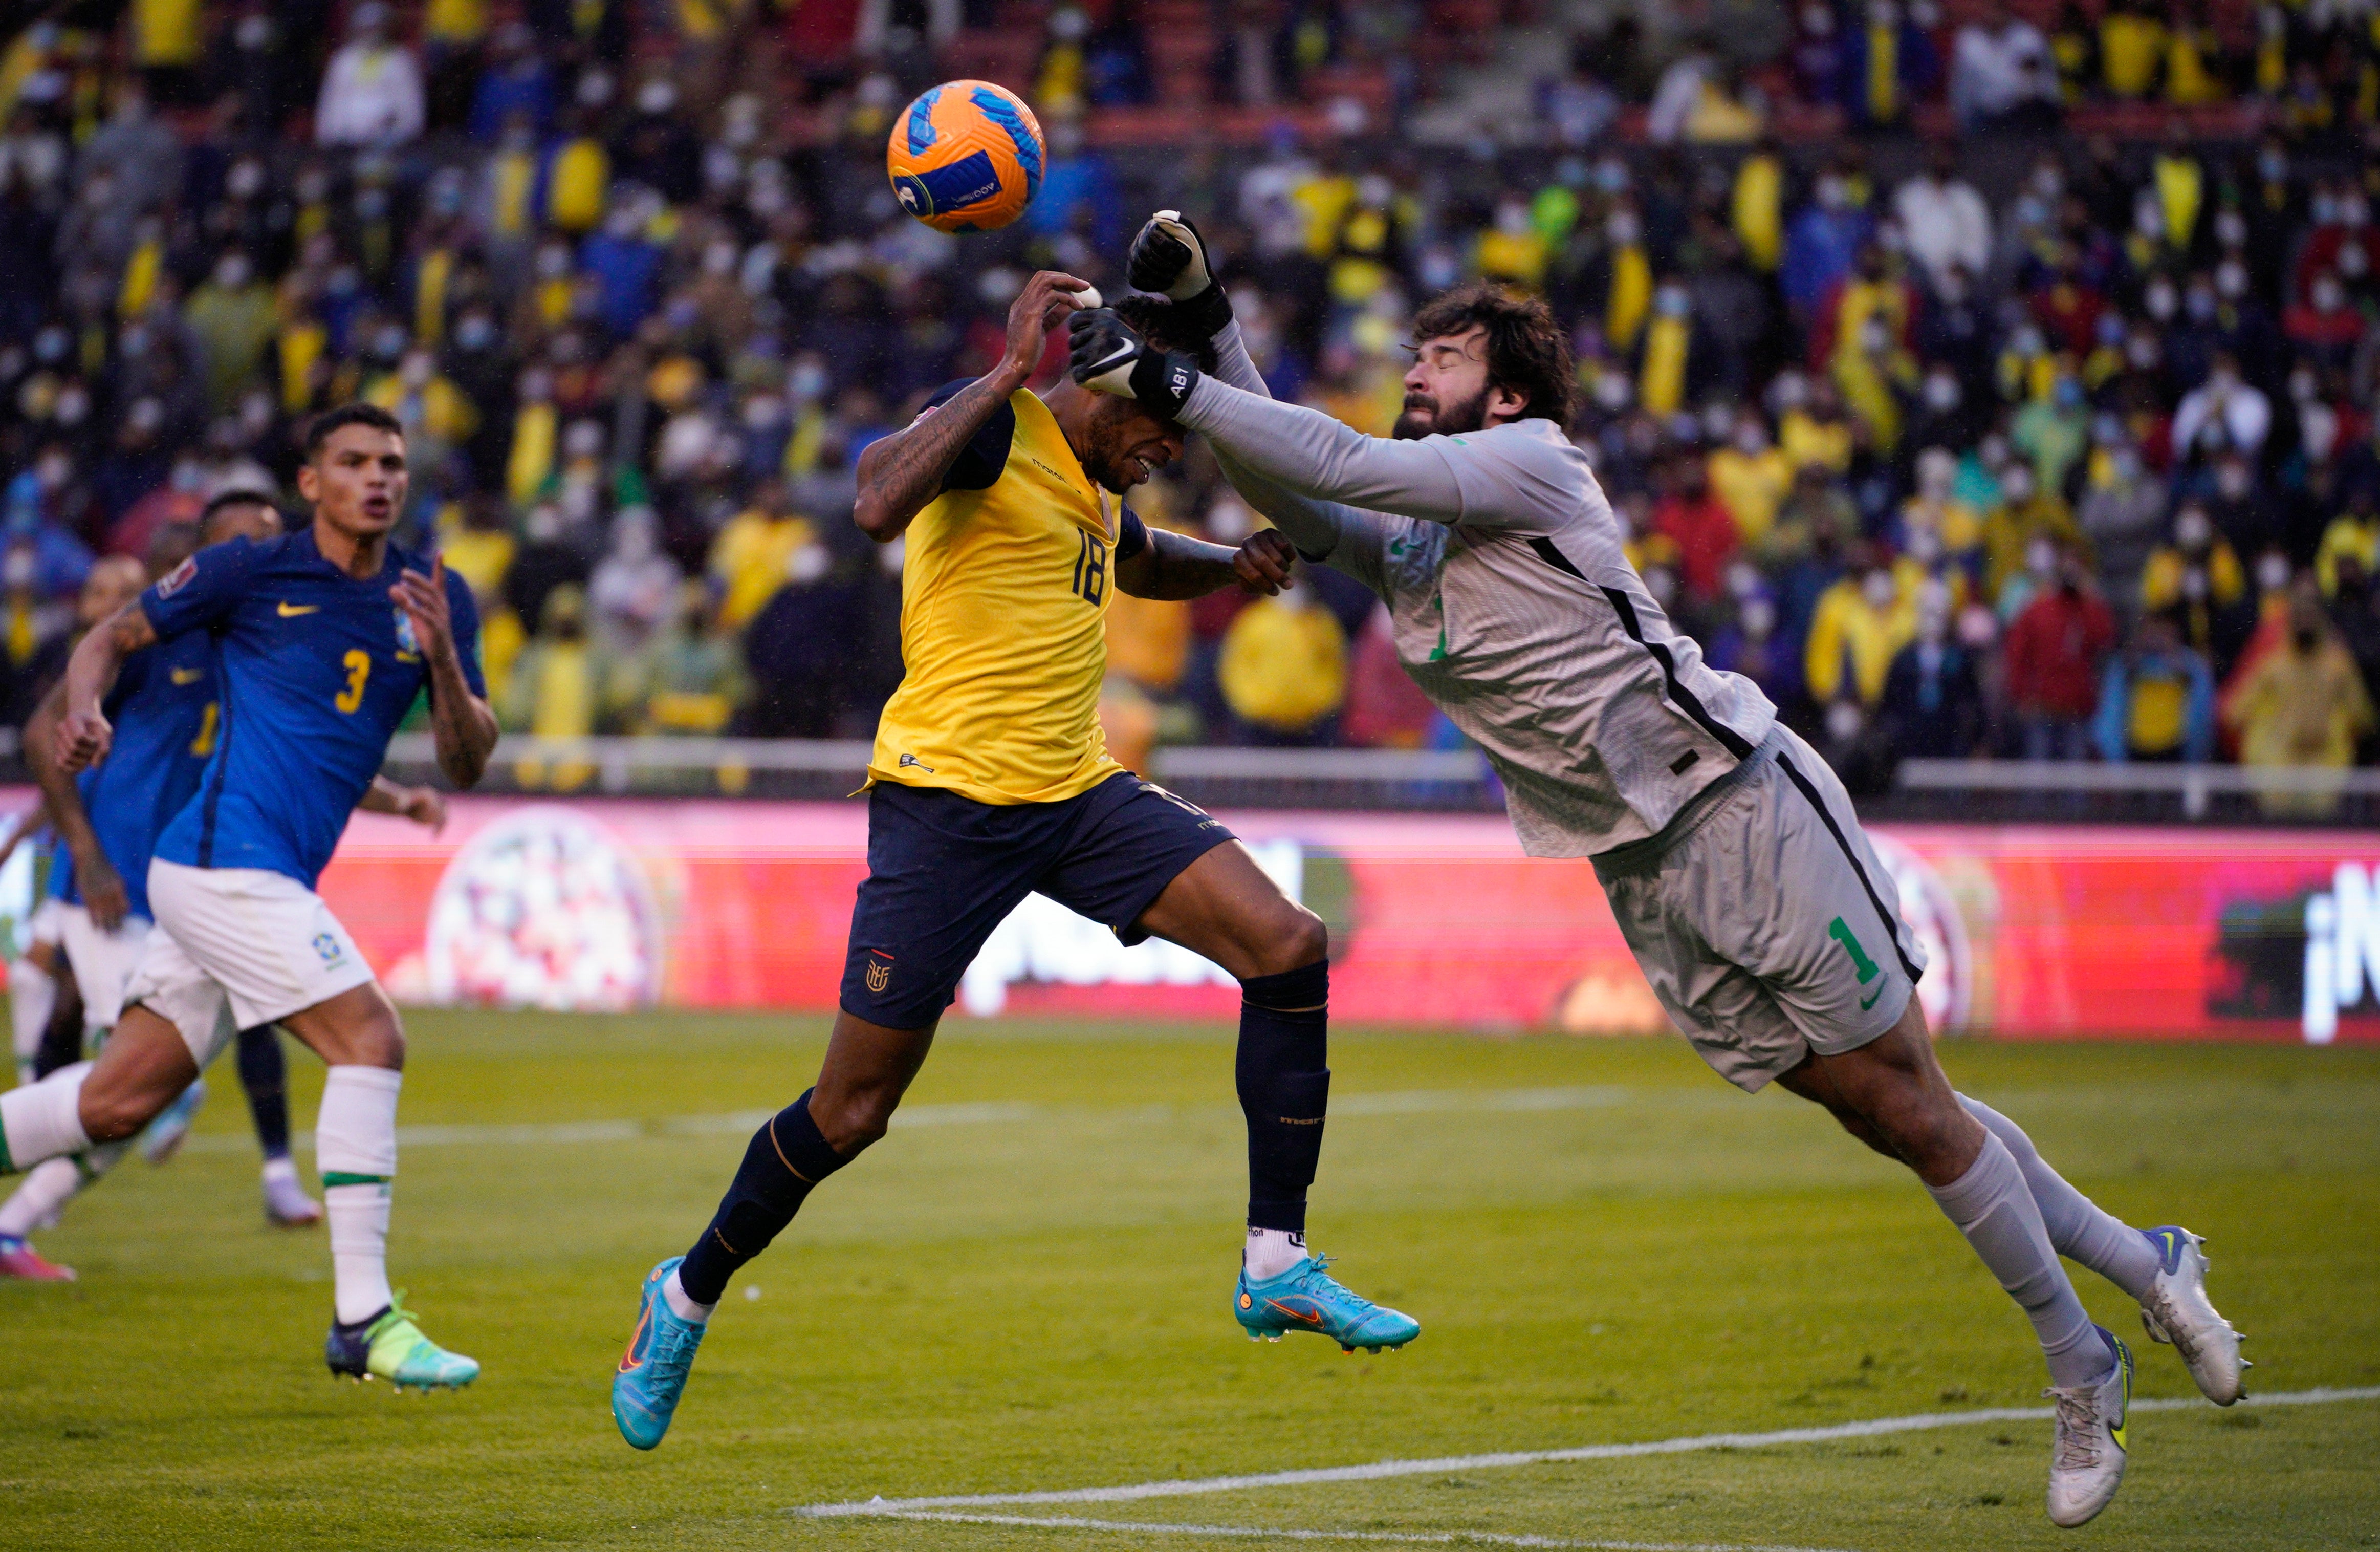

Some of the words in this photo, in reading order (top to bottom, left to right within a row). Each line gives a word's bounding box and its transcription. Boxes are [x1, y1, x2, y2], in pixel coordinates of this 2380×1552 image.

[1170, 367, 1189, 399] AB1
[1072, 526, 1106, 607] 18
[335, 649, 370, 714] 3
[1829, 916, 1879, 985] 1
